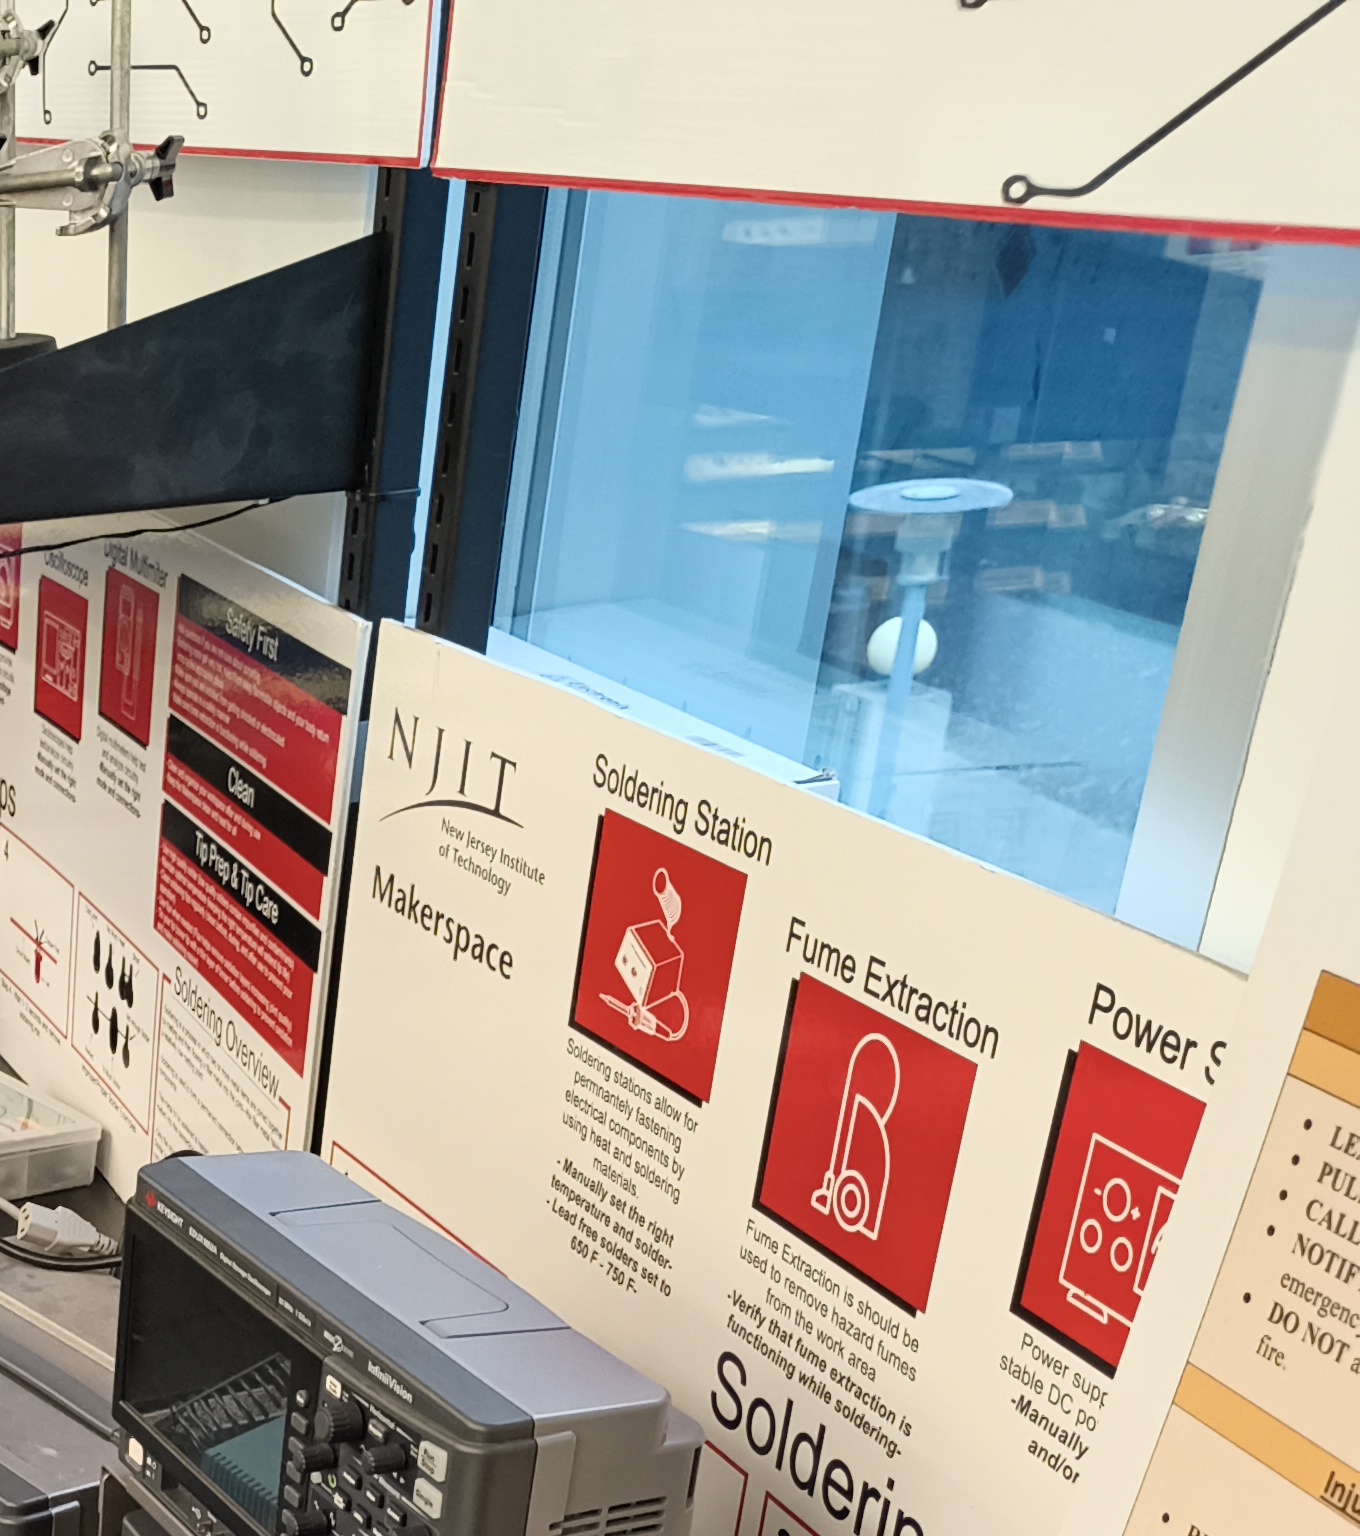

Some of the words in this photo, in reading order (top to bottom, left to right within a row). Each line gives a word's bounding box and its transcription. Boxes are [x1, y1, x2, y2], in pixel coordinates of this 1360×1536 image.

[226, 607, 257, 651] Safety
[257, 623, 279, 662] First
[228, 766, 255, 809] Clean
[387, 706, 517, 816] NJIT
[441, 817, 464, 842] New
[465, 830, 497, 864] Jersey
[499, 847, 546, 885] Institute
[592, 753, 688, 835] Soldering
[694, 799, 773, 867] Station
[195, 830, 209, 867] Tip
[209, 845, 231, 887] Prep
[239, 869, 255, 902] Tip
[255, 885, 279, 925] Care
[438, 845, 450, 858] of
[453, 848, 511, 896] Technology
[371, 864, 514, 980] Makerspace
[173, 966, 223, 1047] Soldering
[225, 1019, 281, 1100] Overview
[785, 916, 857, 984] Fume
[863, 955, 1000, 1060] Extraction
[1087, 982, 1198, 1071] Power
[566, 1037, 612, 1082] Soldering
[613, 1069, 653, 1105] stations
[654, 1095, 682, 1122] allow
[683, 1109, 698, 1134] for
[635, 1107, 682, 1154] fastening
[562, 1111, 588, 1141] using
[590, 1128, 612, 1152] heat
[613, 1144, 632, 1168] and
[634, 1159, 681, 1205] soldering
[565, 1089, 607, 1125] electrical
[608, 1116, 670, 1168] components
[671, 1158, 685, 1181] by
[592, 1156, 639, 1199] materials.
[157, 1202, 184, 1228] KEYSIGHT
[551, 1174, 611, 1228] temperature
[612, 1221, 633, 1243] and
[551, 1198, 578, 1227] Lead
[578, 1220, 598, 1242] free
[600, 1236, 638, 1272] solders
[641, 1264, 660, 1286] set
[661, 1279, 672, 1297] to
[562, 1158, 609, 1200] Manually
[610, 1192, 628, 1214] set
[628, 1205, 646, 1228] the
[647, 1220, 674, 1249] right
[570, 1235, 589, 1259] 650
[606, 1262, 625, 1286] 750
[745, 1218, 780, 1254] Fume
[781, 1243, 841, 1299] Extraction
[844, 1285, 854, 1307] is
[857, 1300, 900, 1340] should
[902, 1329, 920, 1354] be
[739, 1244, 768, 1274] used
[770, 1263, 781, 1284] to
[784, 1277, 829, 1318] remove
[831, 1306, 875, 1350] hazard
[877, 1339, 917, 1382] fumes
[765, 1287, 792, 1319] from
[794, 1309, 813, 1335] the
[816, 1328, 845, 1360] work
[848, 1351, 877, 1383] area
[1021, 1332, 1070, 1379] Power
[726, 1313, 796, 1380] functioning
[798, 1369, 832, 1405] while
[833, 1398, 902, 1459] soldering-
[727, 1289, 767, 1329] -Verify
[768, 1318, 794, 1348] that
[794, 1337, 827, 1373] fume
[829, 1367, 897, 1426] extraction
[900, 1415, 913, 1438] is
[999, 1354, 1044, 1395] stable
[1047, 1383, 1074, 1414] DC
[1010, 1394, 1089, 1461] -Manually
[1028, 1439, 1080, 1484] and/or
